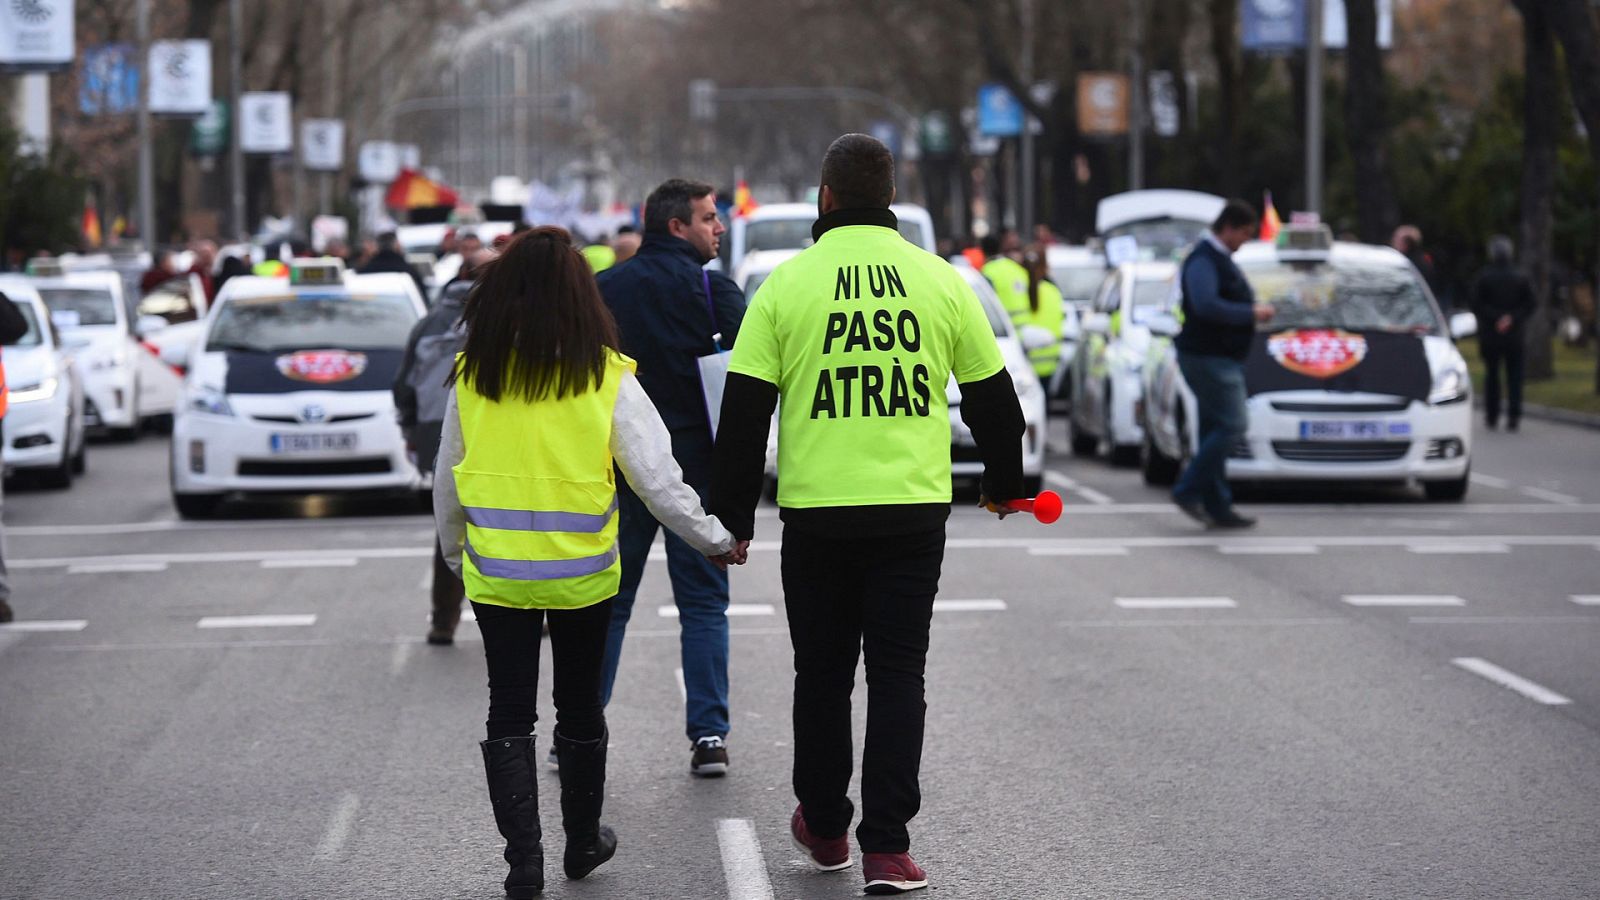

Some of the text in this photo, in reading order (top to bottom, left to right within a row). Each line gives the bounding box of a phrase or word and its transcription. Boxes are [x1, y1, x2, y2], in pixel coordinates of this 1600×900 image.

[835, 264, 908, 300] NI UN
[822, 309, 921, 355] PASO
[810, 357, 931, 420] ATRÀS
